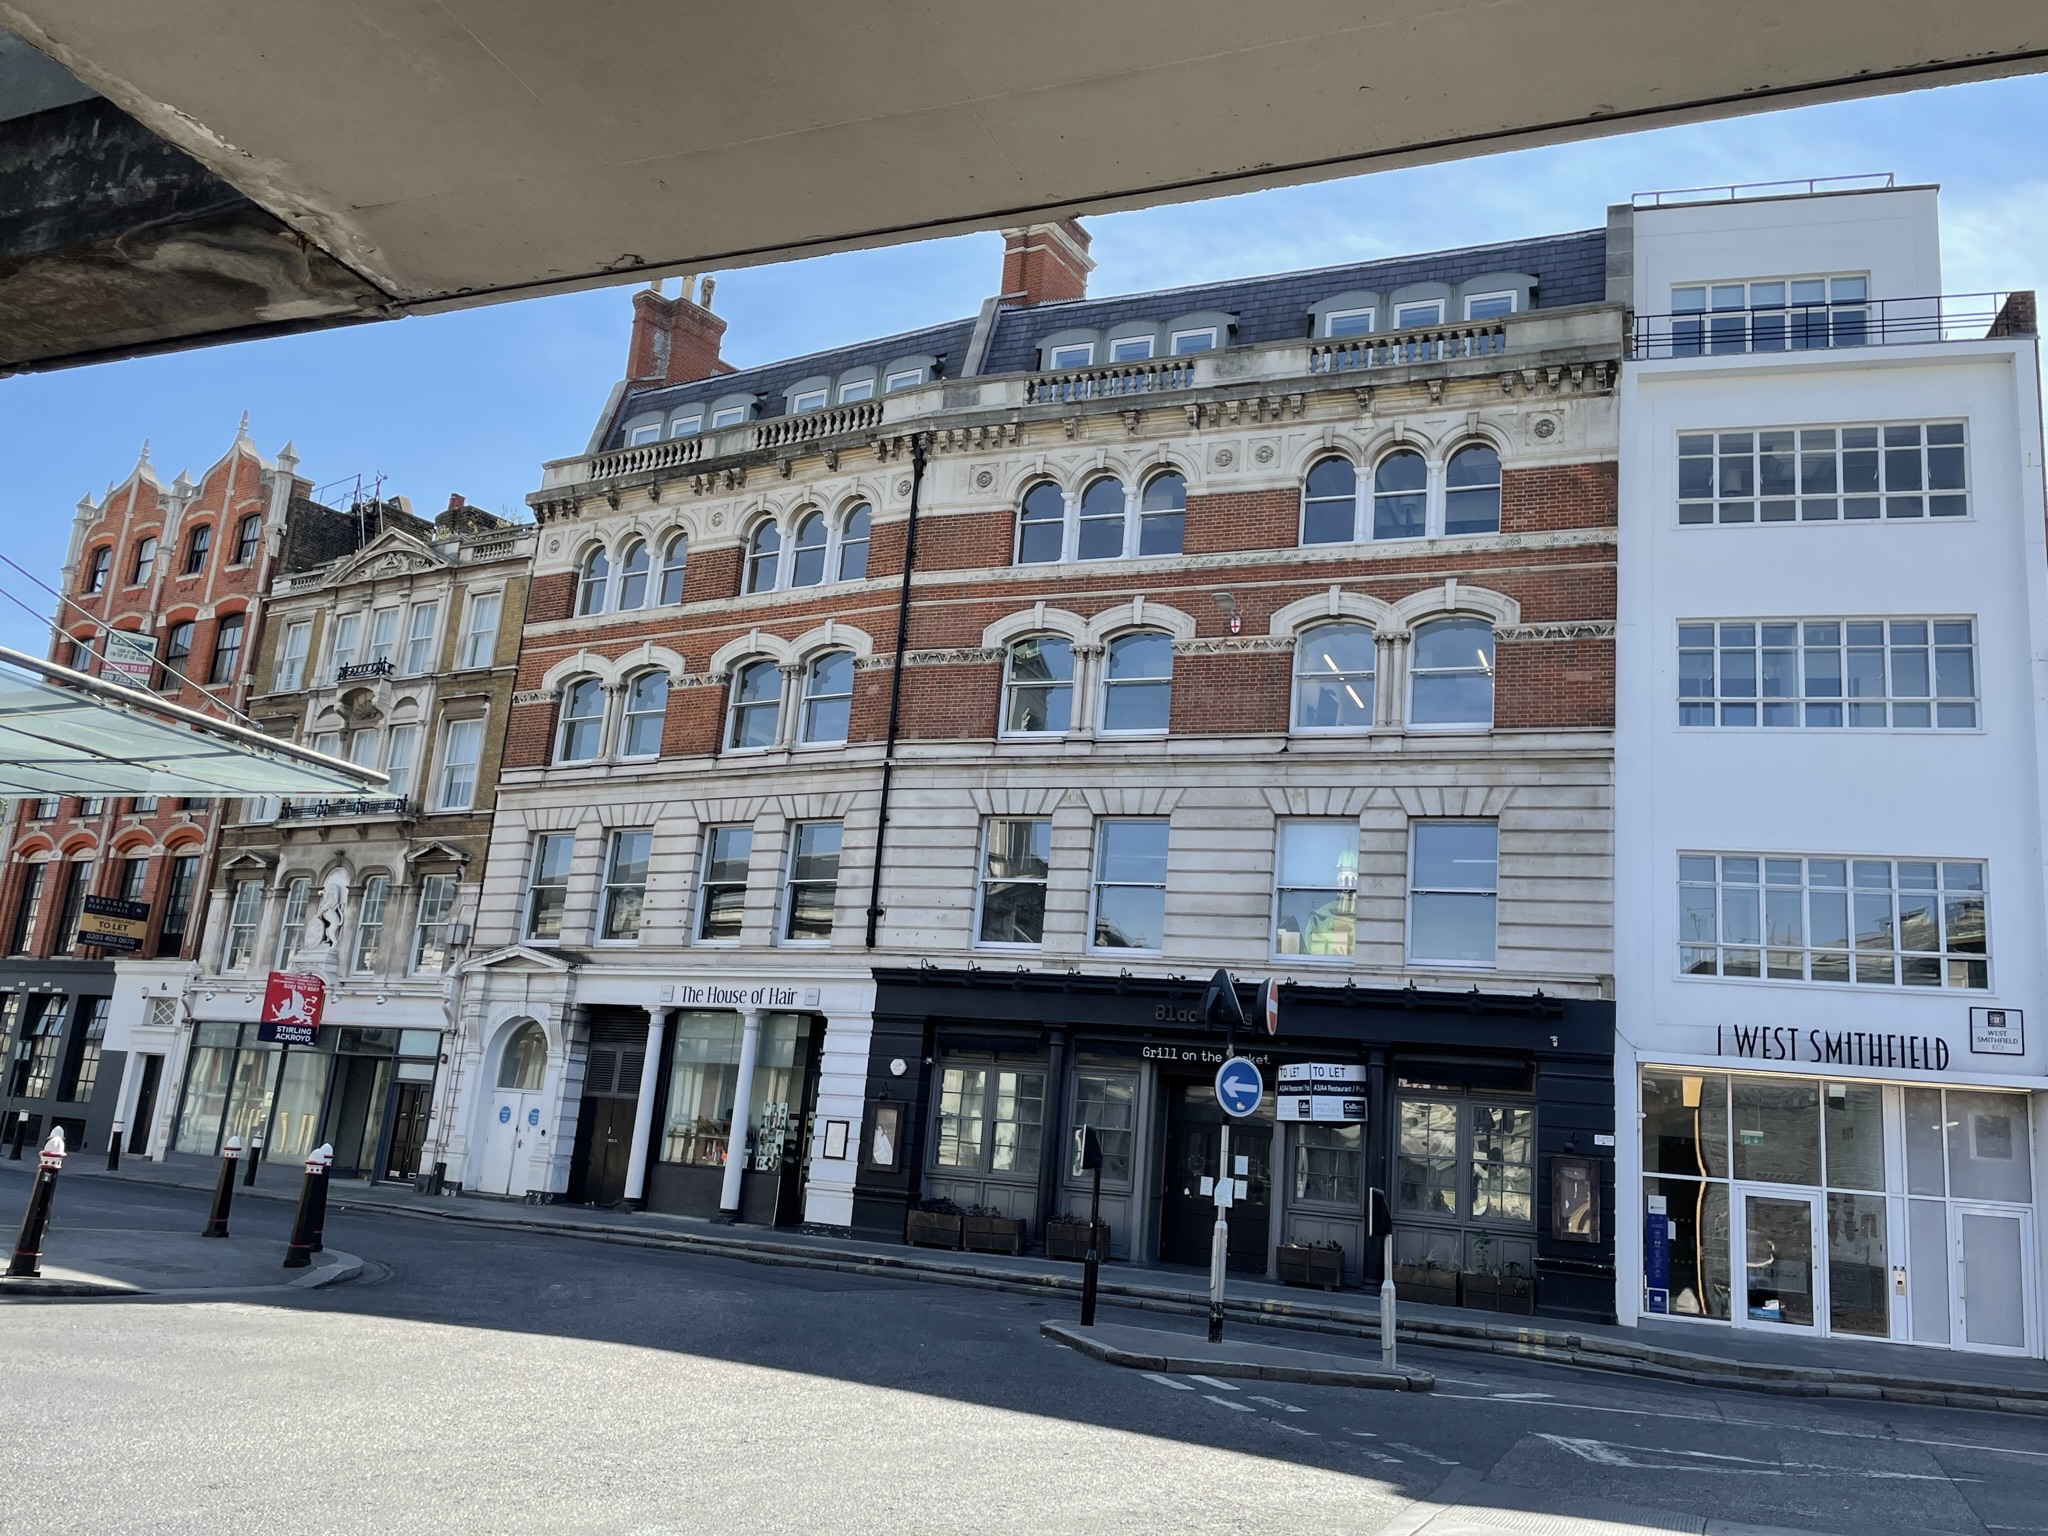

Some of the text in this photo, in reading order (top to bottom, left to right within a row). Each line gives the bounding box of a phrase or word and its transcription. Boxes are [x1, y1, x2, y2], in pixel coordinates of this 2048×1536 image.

[89, 897, 129, 908] NEXTGEN
[88, 903, 128, 914] REAL ESTATE
[99, 920, 129, 931] TO LET
[86, 932, 104, 941] 0203
[161, 982, 168, 991] &
[681, 986, 798, 1005] The House of Hair
[276, 1025, 312, 1035] STIRLING
[274, 1033, 311, 1042] ACKROYD
[1977, 1036, 2019, 1045] SMITHFIELD
[1733, 1024, 1799, 1061] WEST
[1809, 1029, 1950, 1071] SMITHFIELD
[1142, 1046, 1178, 1060] Grill
[1182, 1051, 1197, 1061] on
[1201, 1050, 1222, 1063] the
[1280, 1067, 1299, 1078] TO LET
[1313, 1066, 1346, 1078] TO LET
[1327, 1085, 1352, 1093] Restaurant
